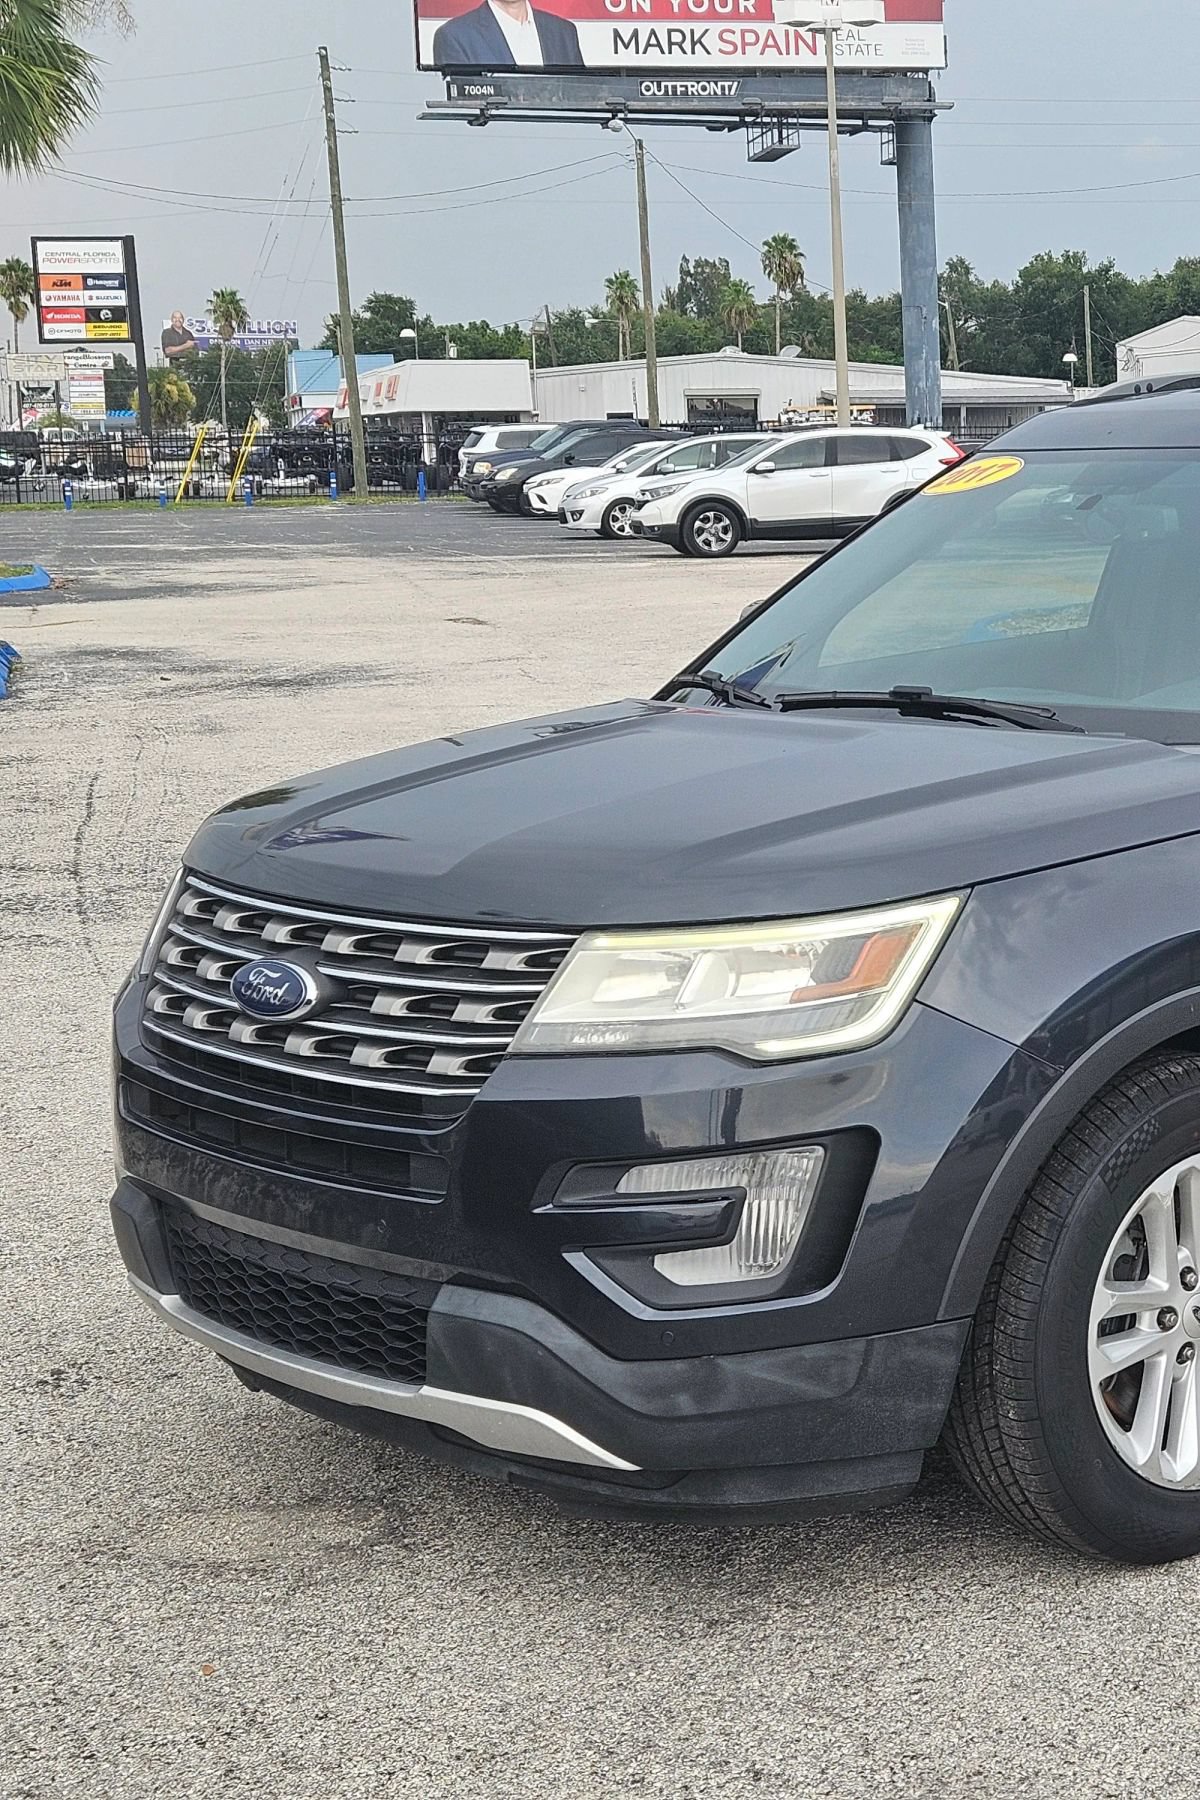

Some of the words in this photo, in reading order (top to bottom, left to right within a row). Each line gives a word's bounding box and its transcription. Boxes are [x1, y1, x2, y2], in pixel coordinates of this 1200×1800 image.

[604, 0, 650, 13] ON
[671, 0, 756, 13] YOUR
[612, 28, 712, 56] MARK
[717, 28, 817, 56] SPAIN
[824, 29, 866, 42] EAL
[825, 43, 884, 57] STATE
[463, 85, 495, 95] 7004N
[53, 294, 81, 302] YAMAHA
[13, 364, 58, 373] STAR
[926, 462, 1019, 490] 2017
[241, 967, 291, 1006] Ford
